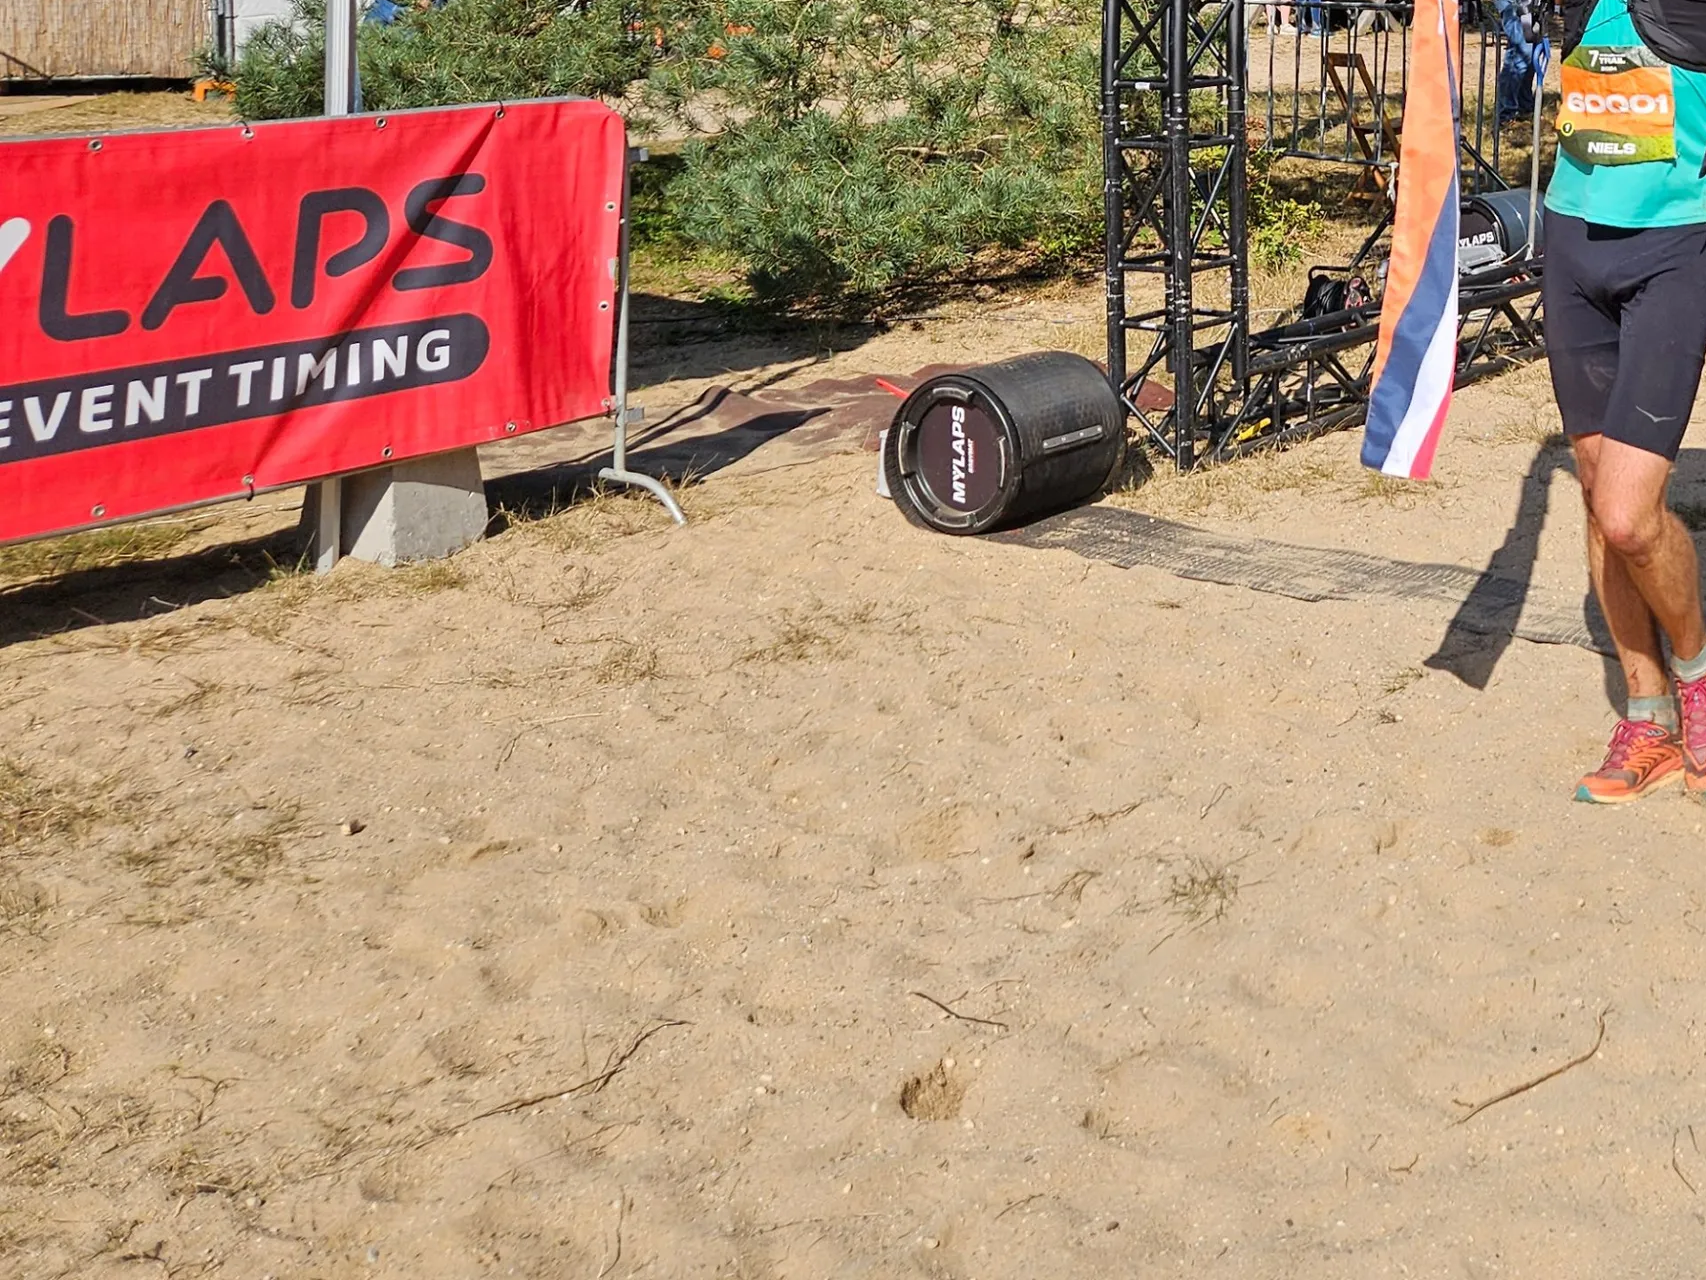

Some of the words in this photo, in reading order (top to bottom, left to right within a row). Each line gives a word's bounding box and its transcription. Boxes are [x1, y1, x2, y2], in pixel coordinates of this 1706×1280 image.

[1588, 50, 1599, 67] 7
[1599, 56, 1626, 64] TRAIL
[1567, 92, 1669, 114] 60001
[1587, 142, 1636, 155] NIELS
[1459, 231, 1495, 247] YLAPS
[0, 173, 493, 341] LAPS
[228, 328, 450, 407] TIMING
[952, 406, 966, 504] MYLAPS
